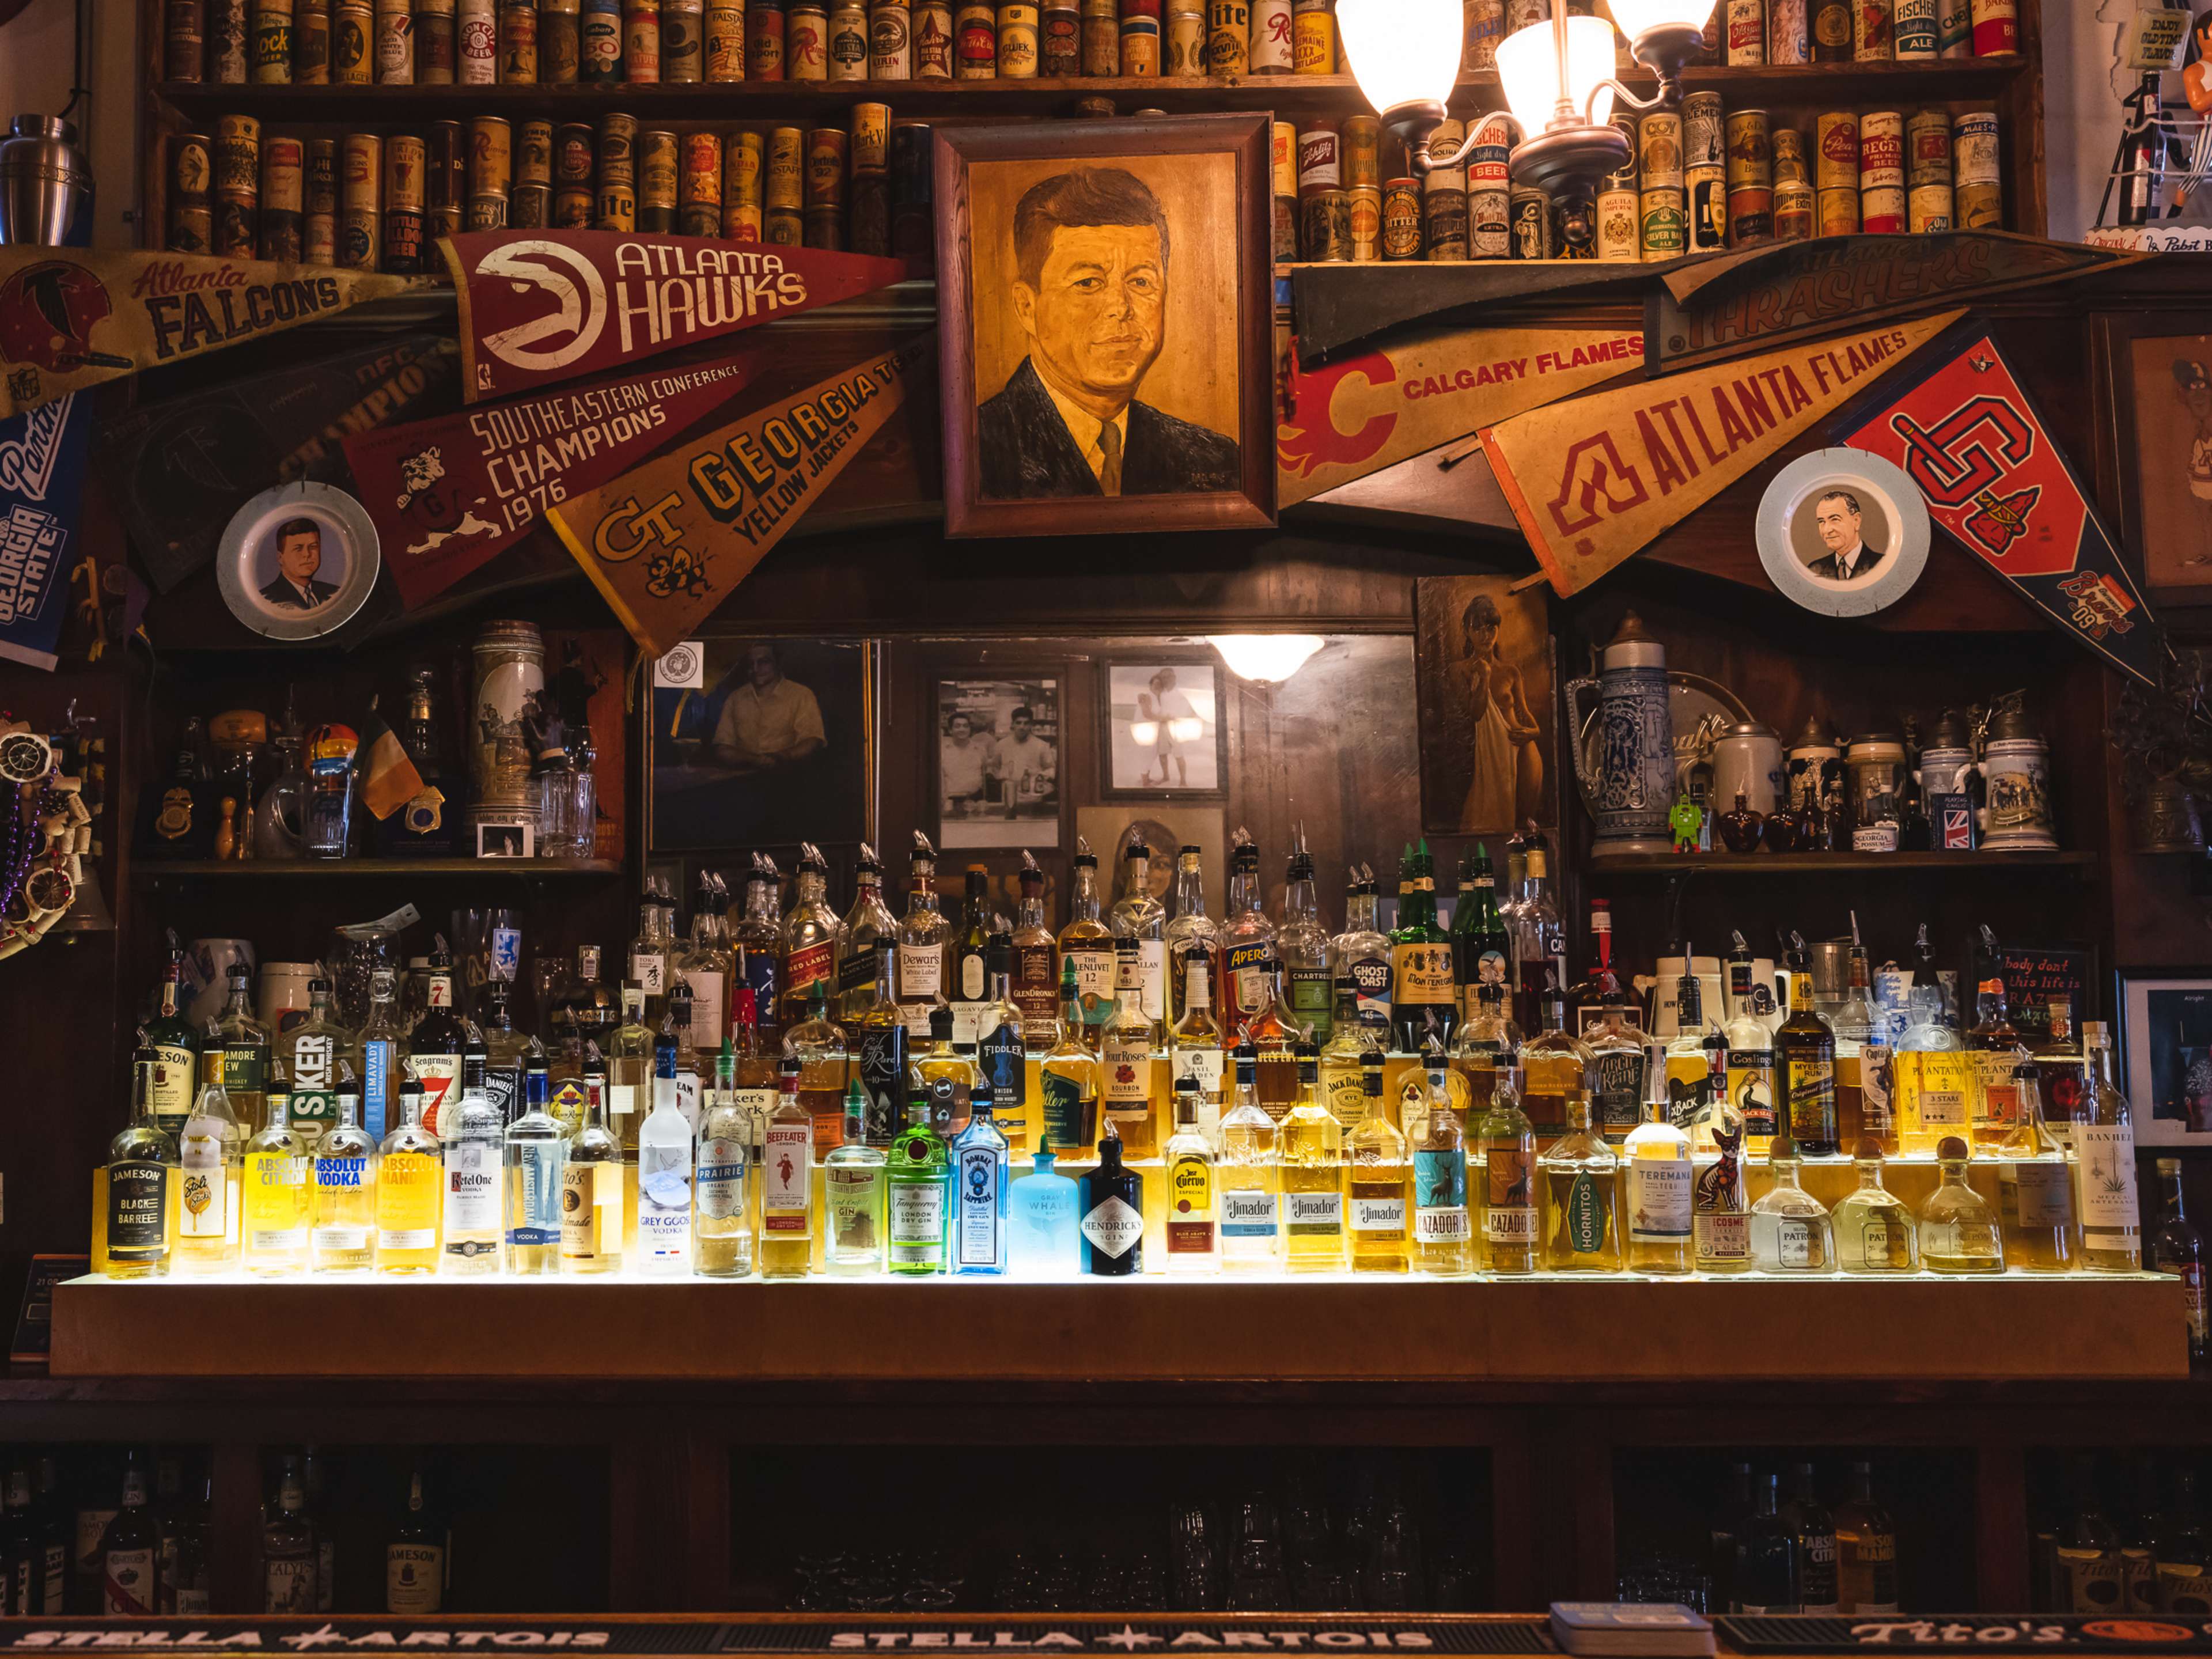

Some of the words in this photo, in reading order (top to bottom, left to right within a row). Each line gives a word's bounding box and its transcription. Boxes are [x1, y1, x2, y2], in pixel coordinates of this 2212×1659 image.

[2151, 19, 2180, 31] ENJOY
[462, 22, 482, 45] IRON
[480, 21, 495, 46] CITY
[584, 41, 617, 55] 50
[1910, 39, 1933, 49] ALE
[466, 48, 493, 58] BEER
[872, 58, 899, 66] KIRIN
[347, 72, 370, 83] LAGER
[1303, 142, 1332, 165] Schlitz
[1476, 166, 1506, 176] BEER
[1646, 233, 1671, 243] SILVER
[2165, 237, 2200, 251] Pabst
[616, 243, 784, 275] ATLANTA
[132, 262, 248, 300] Atlanta
[1687, 238, 1991, 347] THRASHERS
[145, 277, 340, 359] FALCONS
[616, 274, 808, 353] HAWKS
[355, 348, 417, 384] NFC
[1403, 358, 1529, 400] CALGARY
[1536, 336, 1645, 375] FLAMES
[469, 382, 646, 459] SOUTHEASTERN
[652, 365, 740, 400] CONFERENCE
[1635, 366, 1814, 497] ATLANTA
[1808, 330, 1908, 396] FLAMES
[487, 404, 666, 499] CHAMPIONS
[689, 374, 879, 524] GEORGIA
[733, 475, 809, 548] YELLOW
[809, 422, 860, 480] JACKETS
[502, 478, 567, 533] 1976
[17, 527, 58, 615] STATE
[2058, 570, 2135, 634] Braves
[787, 963, 804, 972] RED
[805, 953, 831, 966] LABEL
[903, 953, 940, 966] Dewar's
[2004, 957, 2034, 970] body
[2037, 960, 2069, 972] dont
[1353, 966, 1387, 977] GHOST
[2010, 978, 2036, 987] this
[2041, 976, 2063, 988] life
[433, 986, 444, 1004] 7
[1365, 1012, 1373, 1020] 45
[325, 1037, 333, 1062] WHISKEY
[984, 1045, 1023, 1057] FIDDLER
[1105, 1051, 1121, 1061] Four
[1122, 1052, 1146, 1061] Roses
[415, 1058, 453, 1067] Seagram's
[1732, 1054, 1772, 1065] Goslings
[325, 1063, 333, 1083] IRISH
[368, 1044, 378, 1097] LIMAVADY
[486, 1077, 514, 1093] DANIEL'S
[1328, 1080, 1346, 1093] JACK
[1791, 1087, 1818, 1099] Original
[767, 1132, 806, 1144] BEEFEATER
[2086, 1132, 2133, 1142] BANHEZ
[522, 1146, 533, 1166] NEW
[965, 1154, 992, 1165] BOMBAY
[256, 1158, 309, 1171] ABSOLUT
[315, 1158, 366, 1172] ABSOLUT
[382, 1158, 437, 1171] ABSOLUT
[113, 1169, 161, 1181] JAMESON
[262, 1172, 306, 1185] CITRON
[317, 1172, 361, 1185] VODKA
[699, 1165, 742, 1179] PRAIRIE
[1639, 1170, 1691, 1180] TEREMANA
[185, 1176, 208, 1198] Stoli
[452, 1172, 475, 1192] Ketel
[475, 1176, 492, 1185] One
[1176, 1176, 1205, 1188] Cuervo
[120, 1198, 158, 1209] BLACK
[522, 1168, 534, 1228] AMSTERDAM
[896, 1198, 938, 1209] Tanqueray
[964, 1191, 993, 1203] SAPPHIRE
[839, 1207, 855, 1215] GIN
[1029, 1202, 1070, 1210] WHALE
[1229, 1200, 1272, 1218] Jimador
[1294, 1199, 1337, 1218] Jimador
[118, 1214, 158, 1224] BARREL
[641, 1217, 661, 1226] GREY
[1362, 1206, 1402, 1224] Jimador
[1581, 1183, 1592, 1248] HORNITOS
[1716, 1218, 1744, 1226] COSME
[1085, 1221, 1142, 1231] HENDRICK'S
[387, 1550, 436, 1563] JAMESON
[13, 1630, 262, 1647] STELLA
[346, 1630, 609, 1647] ARTOIS
[1851, 1621, 2068, 1644] Tito's
[829, 1631, 1084, 1649] STELLA
[1171, 1631, 1434, 1649] ARTOIS
